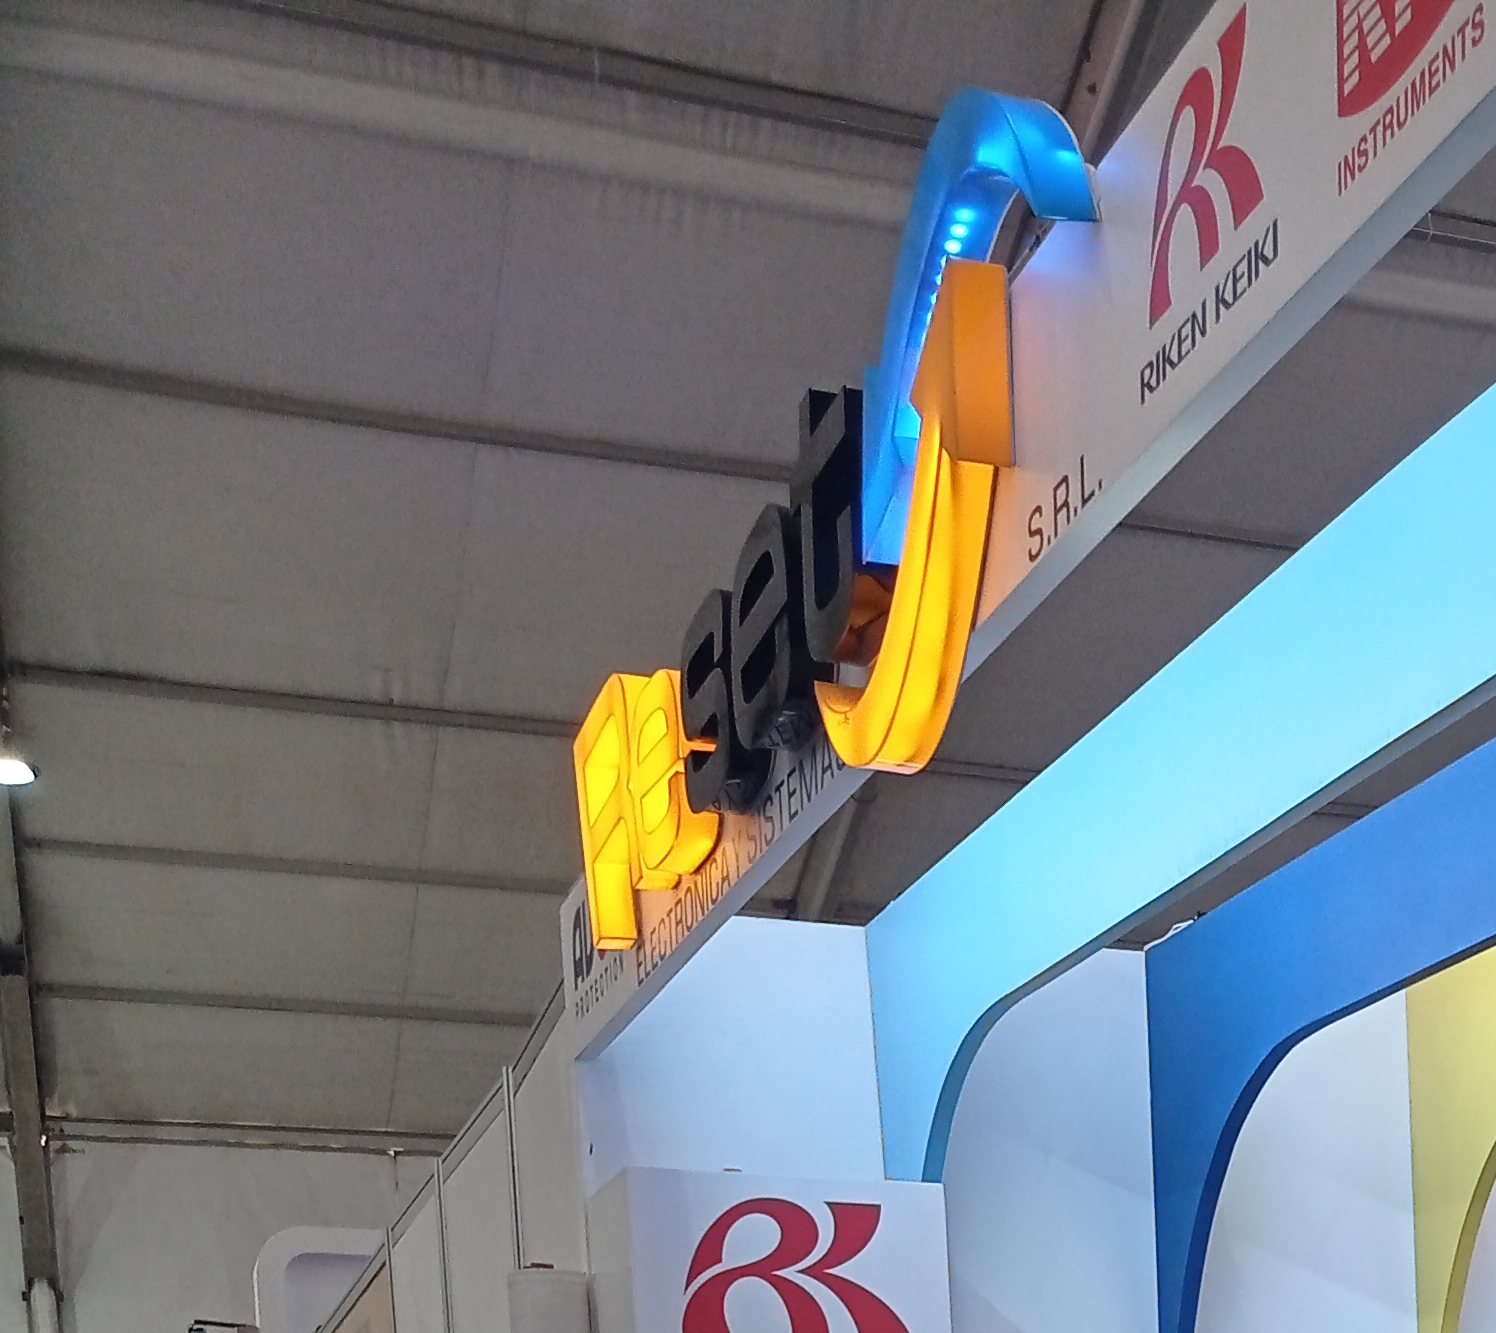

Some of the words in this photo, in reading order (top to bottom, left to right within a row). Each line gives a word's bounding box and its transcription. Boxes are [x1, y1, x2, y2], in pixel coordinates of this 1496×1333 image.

[1336, 4, 1486, 197] INSTRUMENTS
[1139, 307, 1208, 405] RIKEN
[1213, 218, 1280, 325] KEIKI
[1026, 455, 1104, 563] S.R.L.
[636, 849, 732, 986] ELECTRONICA
